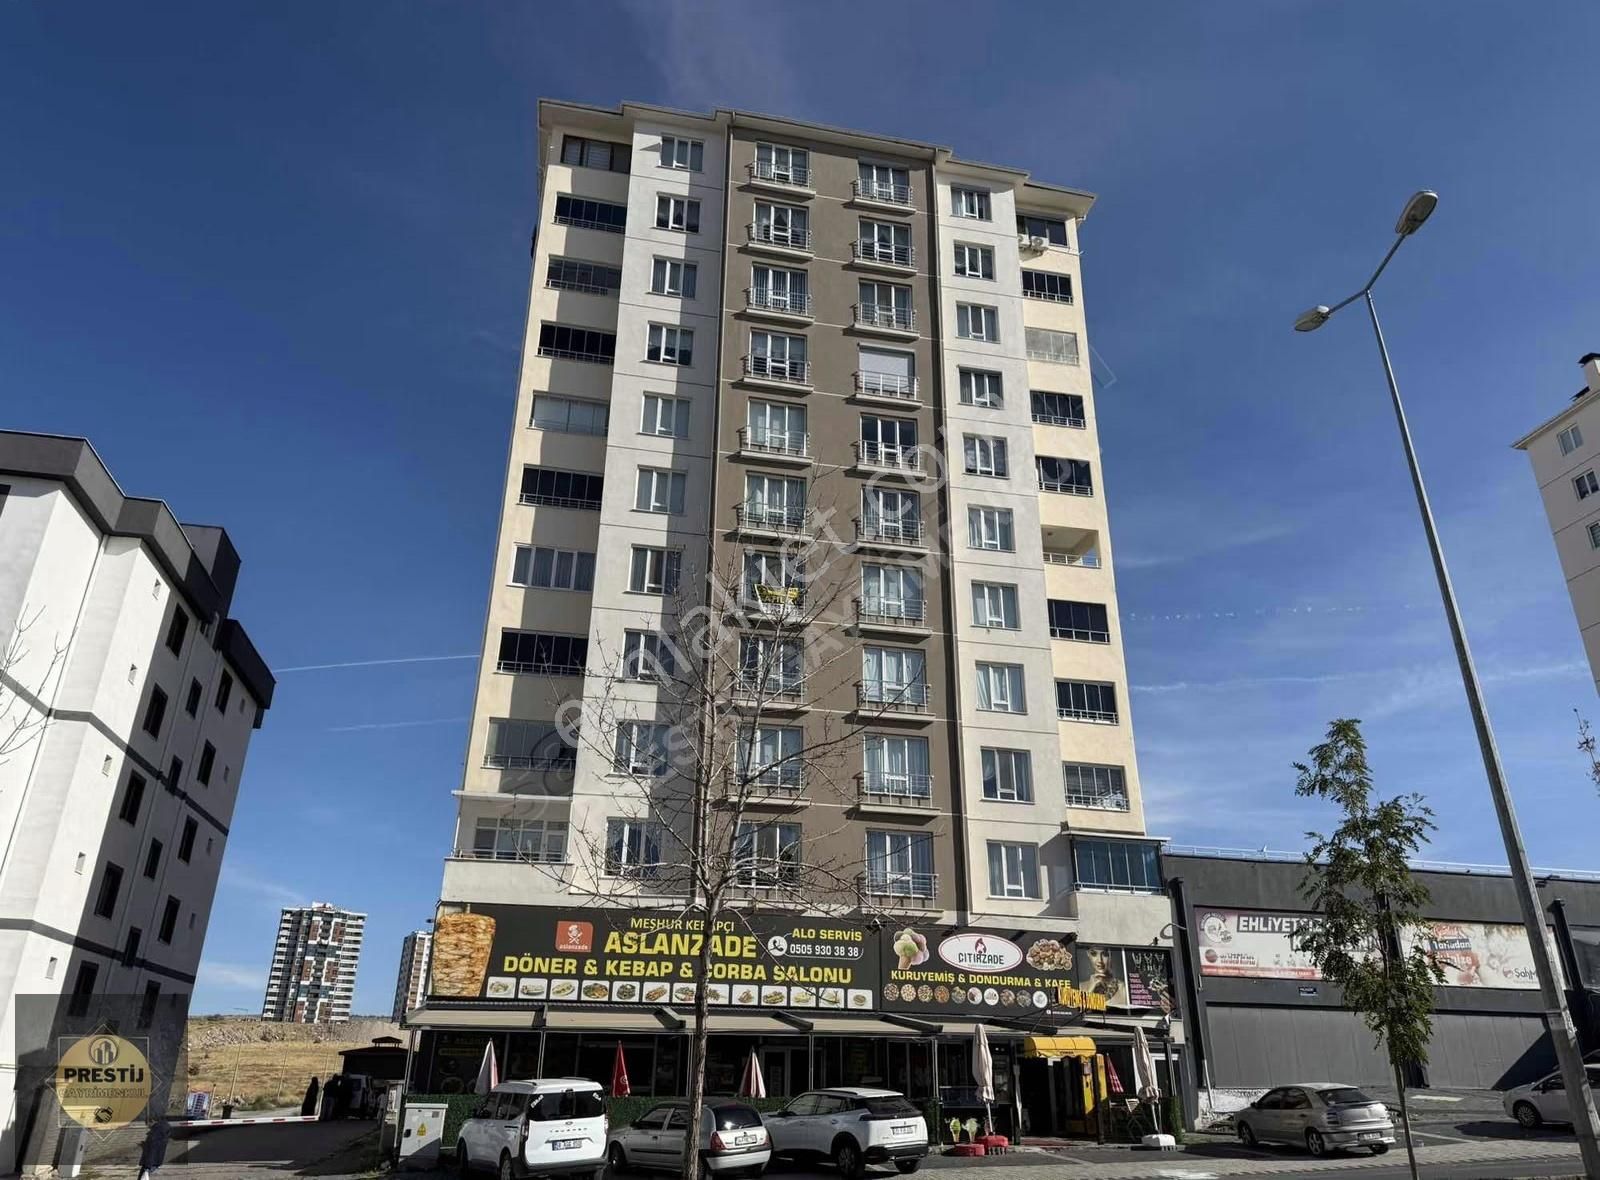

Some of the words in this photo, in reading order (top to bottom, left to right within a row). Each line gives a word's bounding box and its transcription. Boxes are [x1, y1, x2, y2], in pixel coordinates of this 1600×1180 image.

[630, 917, 682, 931] MEŞHUR
[792, 928, 815, 939] ALO
[820, 928, 863, 942] SERVİS
[604, 931, 757, 958] ASLANZADE
[790, 944, 812, 955] 0505
[815, 945, 831, 956] 930
[834, 946, 845, 957] 38
[848, 947, 859, 957] 38
[504, 953, 577, 975] DÖNER
[584, 959, 598, 976] &
[605, 960, 673, 977] KEBAP
[680, 962, 693, 978] &
[773, 964, 852, 984] SALONU
[891, 970, 955, 985] KURUYEMİŞ
[958, 973, 966, 983] &
[969, 974, 1031, 987] DONDURMA
[1034, 978, 1042, 987] &
